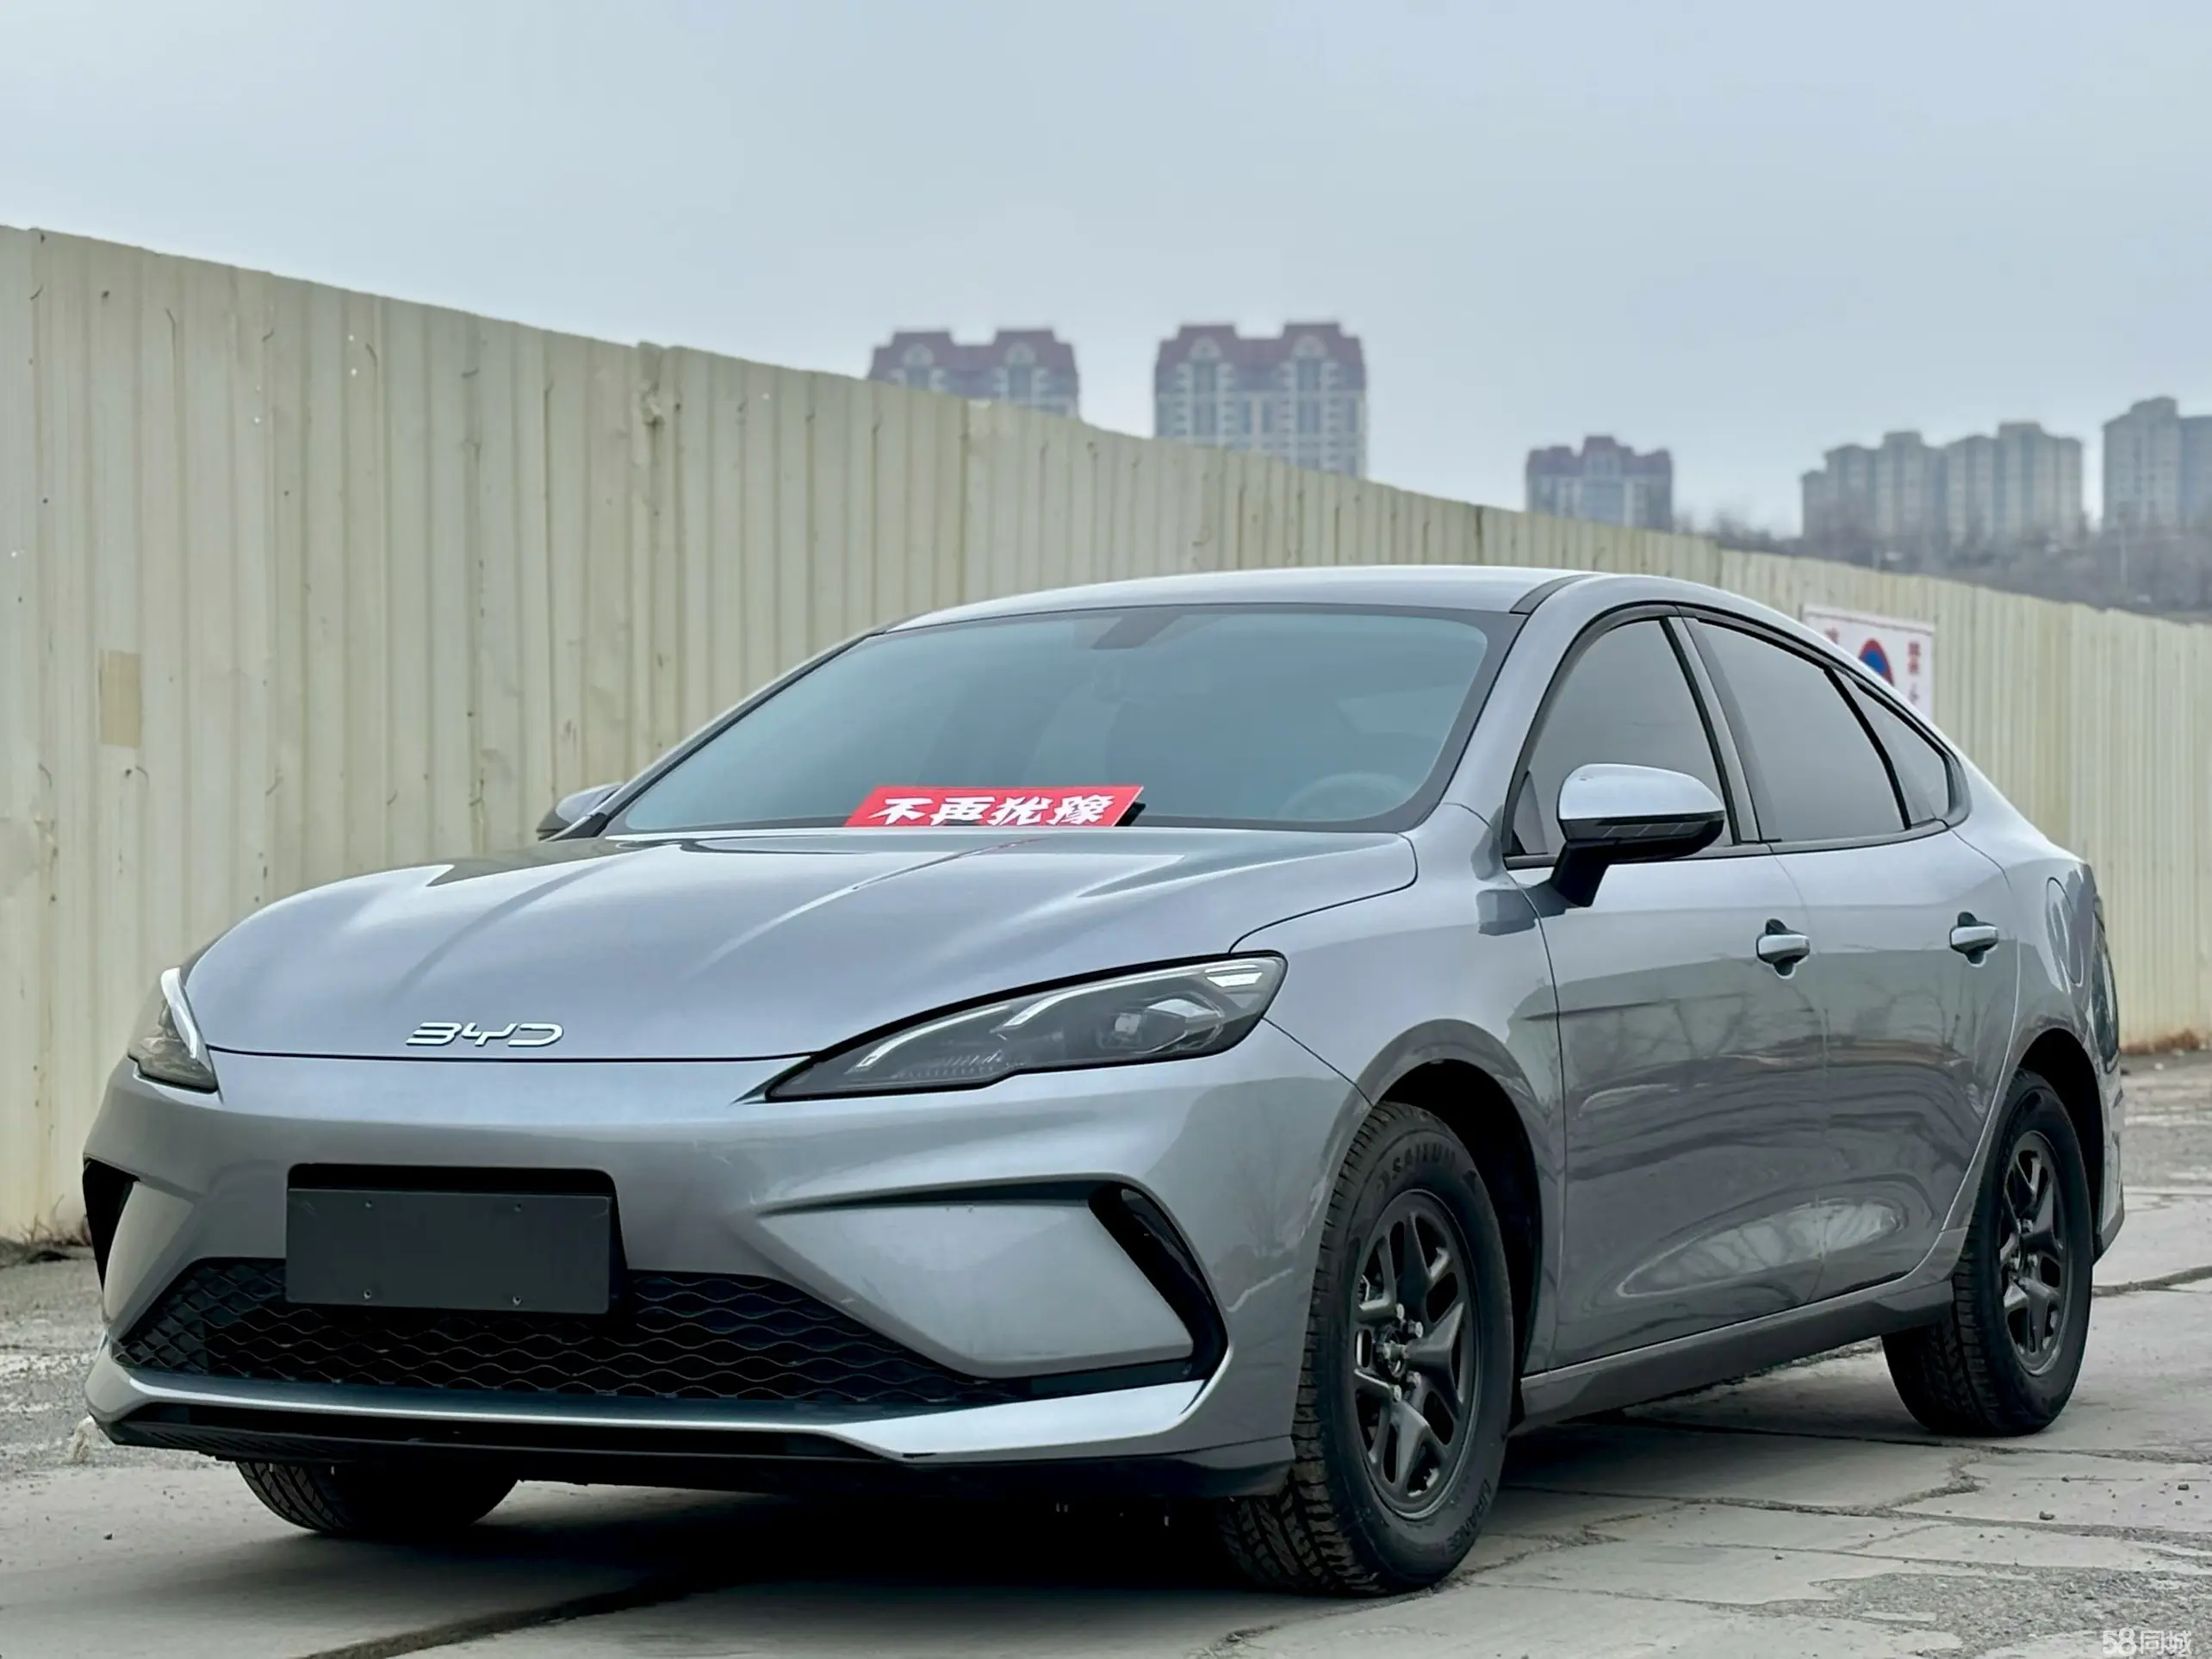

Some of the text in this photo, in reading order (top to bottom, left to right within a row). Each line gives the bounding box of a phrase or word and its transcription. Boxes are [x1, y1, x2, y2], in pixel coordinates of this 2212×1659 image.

[868, 795, 1115, 825] 不再犹豫
[406, 1022, 563, 1047] BYD
